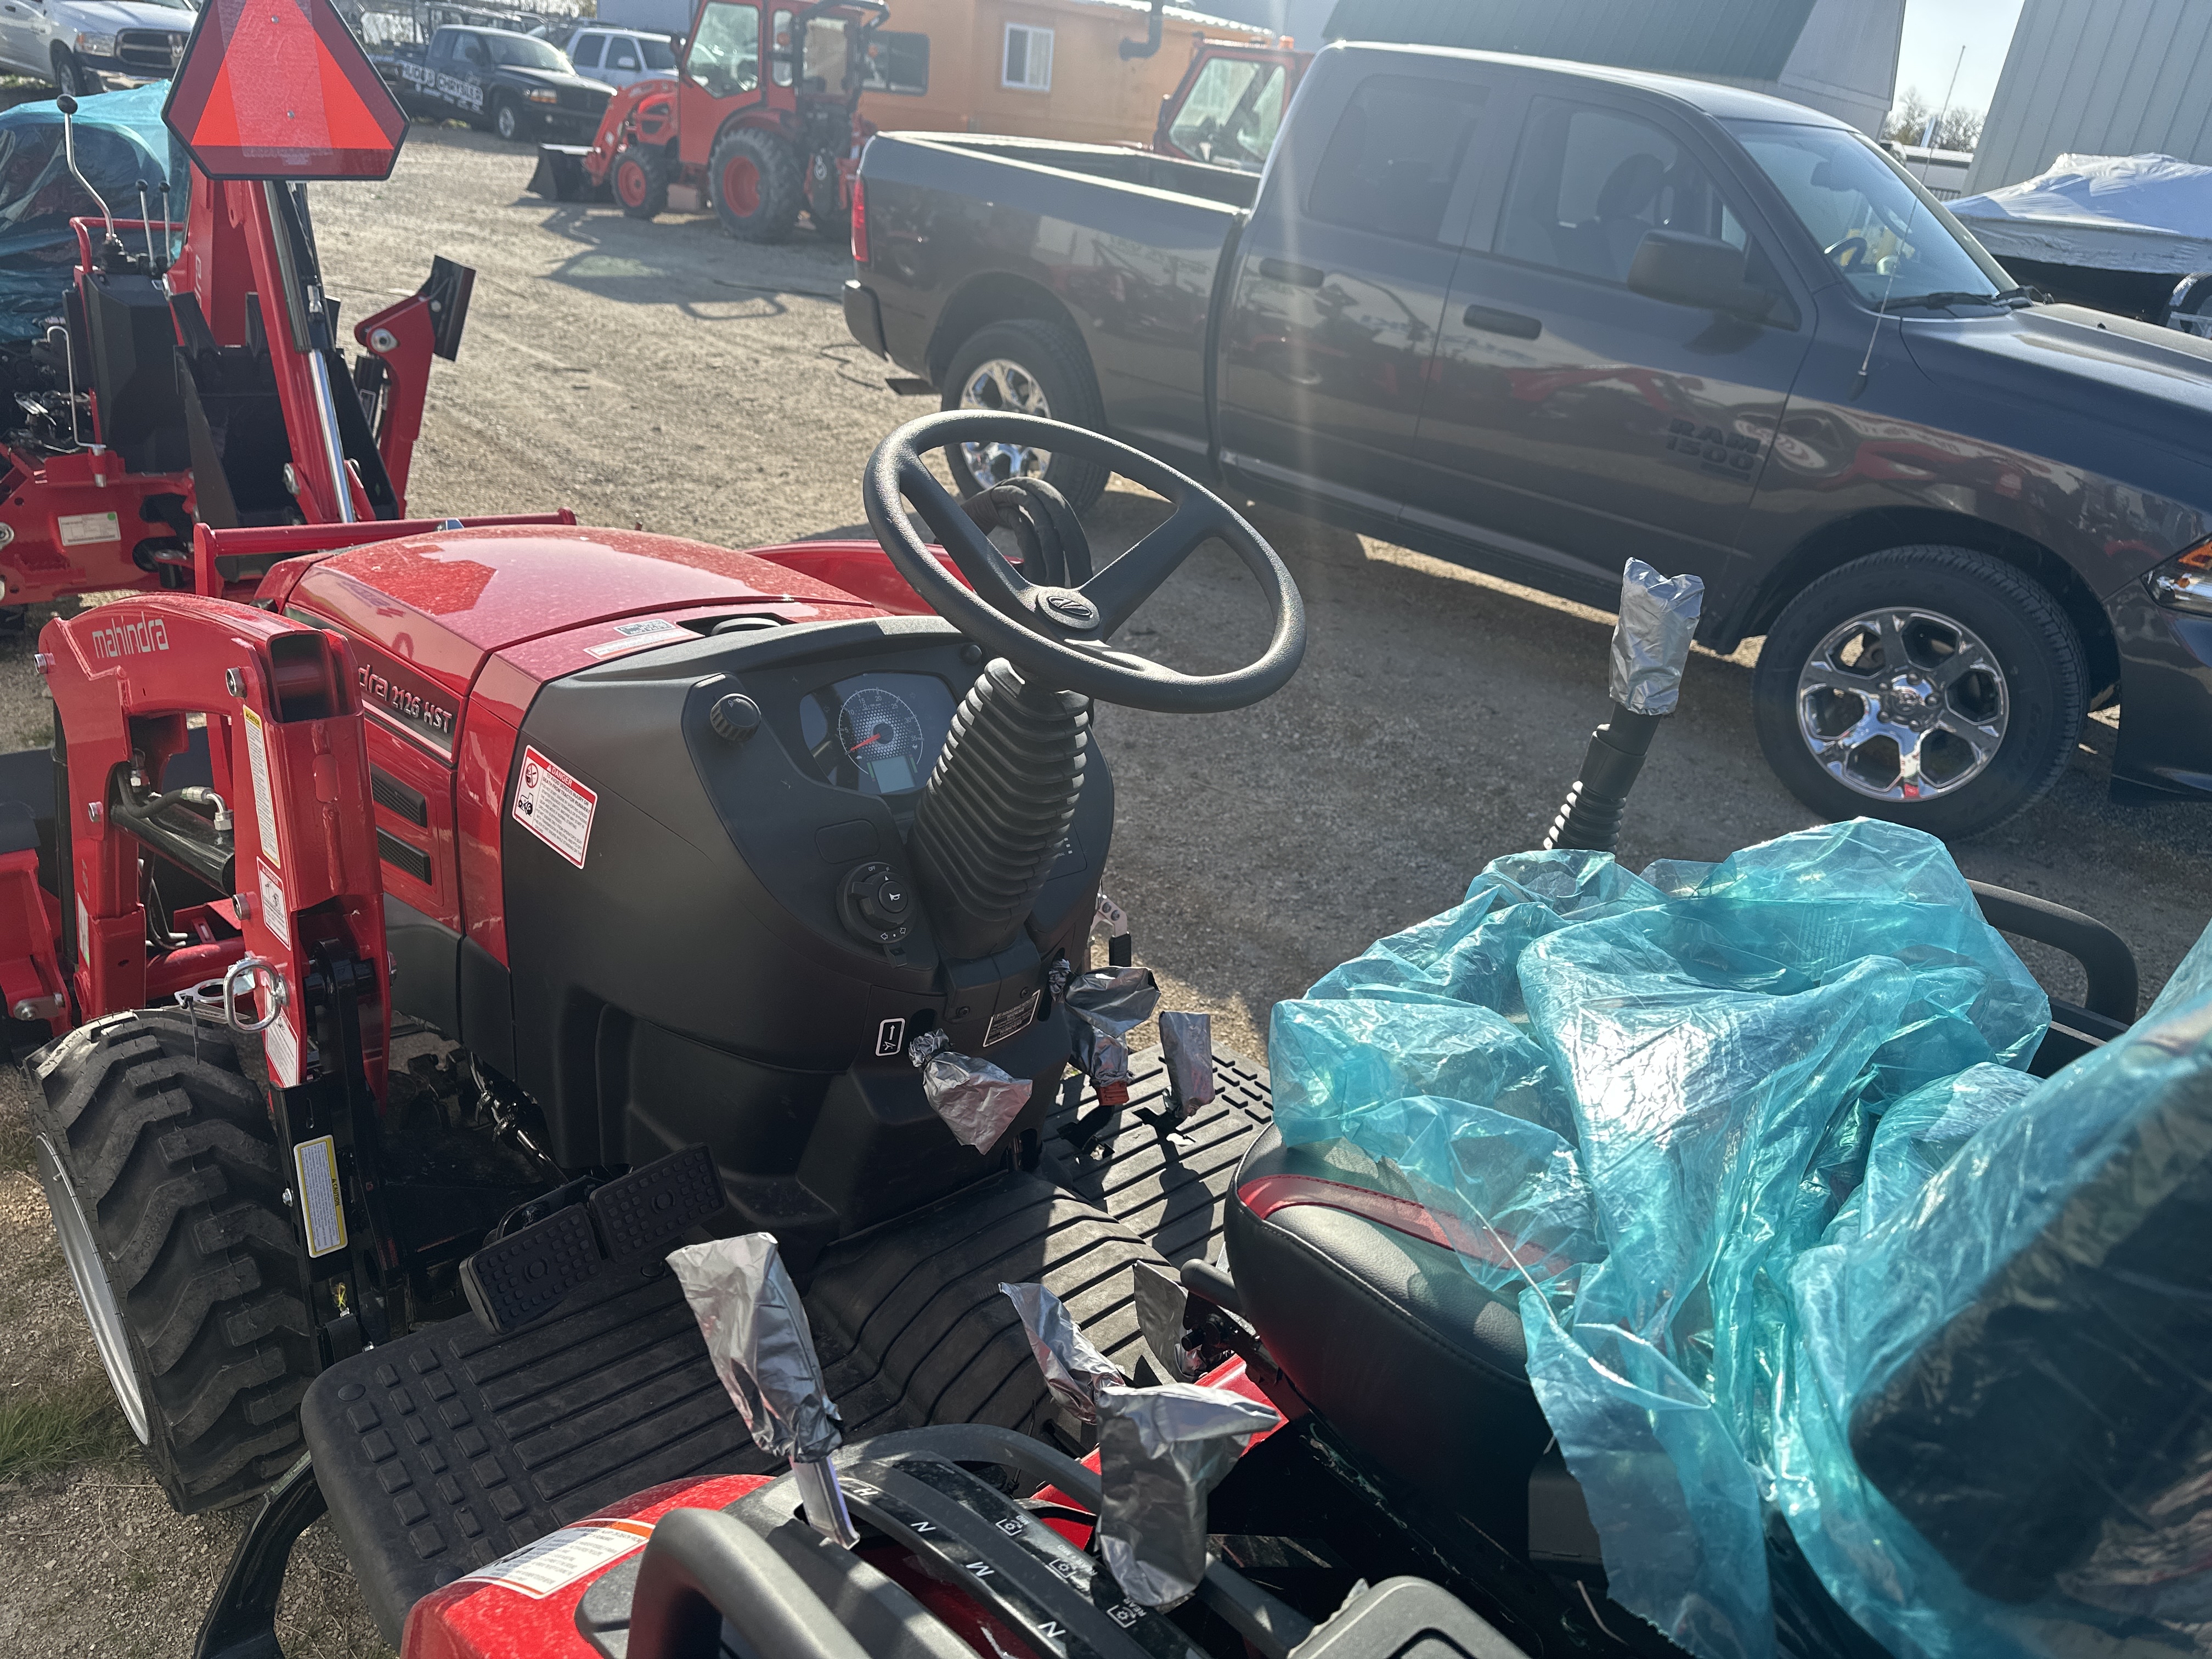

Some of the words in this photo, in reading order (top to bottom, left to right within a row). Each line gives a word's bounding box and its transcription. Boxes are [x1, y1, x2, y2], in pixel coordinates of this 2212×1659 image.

[1669, 418, 1760, 454] RAM
[1666, 436, 1754, 471] 1500
[92, 611, 169, 658] mahindra
[392, 686, 421, 719] 2126
[424, 702, 452, 728] HST
[551, 766, 573, 787] DANGER
[853, 1488, 878, 1496] H
[910, 1521, 936, 1532] N
[1015, 1515, 1031, 1526] MID
[966, 1562, 995, 1577] M
[1123, 1596, 1147, 1618] REAR
[1038, 1621, 1066, 1638] N
